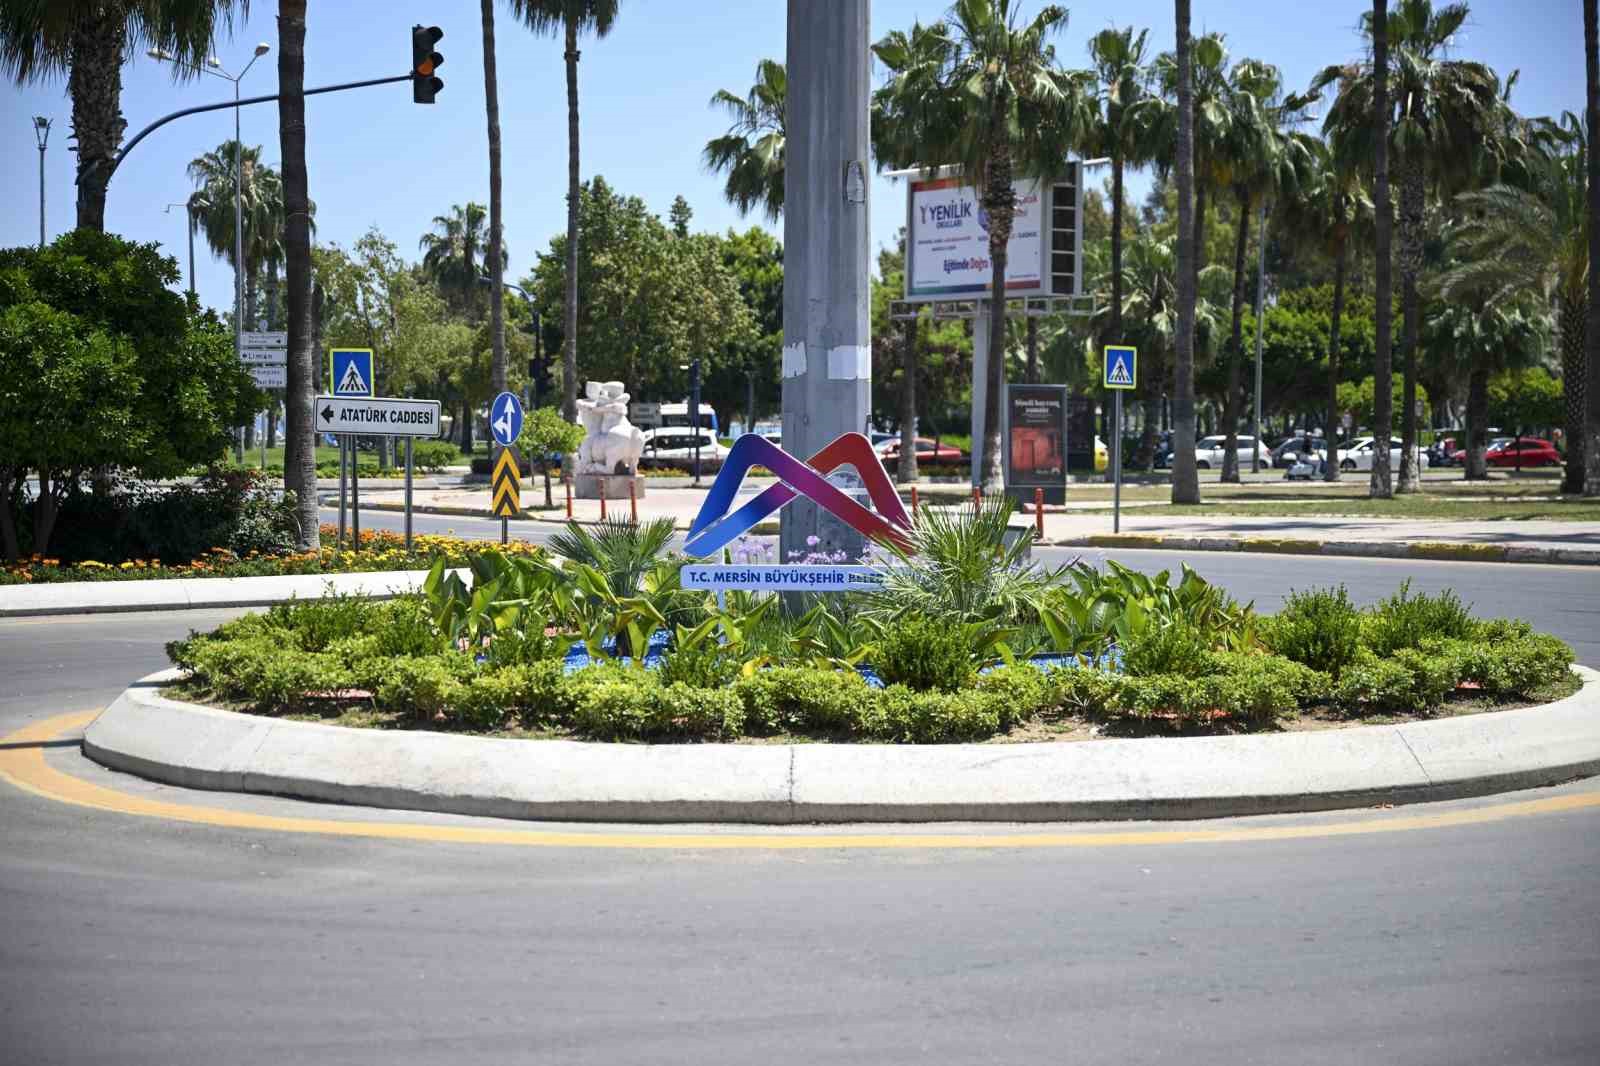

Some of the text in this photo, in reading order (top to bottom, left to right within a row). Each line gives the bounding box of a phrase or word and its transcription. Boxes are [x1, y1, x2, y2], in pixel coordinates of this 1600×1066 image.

[929, 198, 972, 222] YENİLİK
[340, 407, 433, 424] ATATÜRK CADDESİ
[690, 572, 710, 583] T.C.
[713, 569, 761, 583] MERSİN
[765, 569, 844, 587] BÜYÜKŞEHİR
